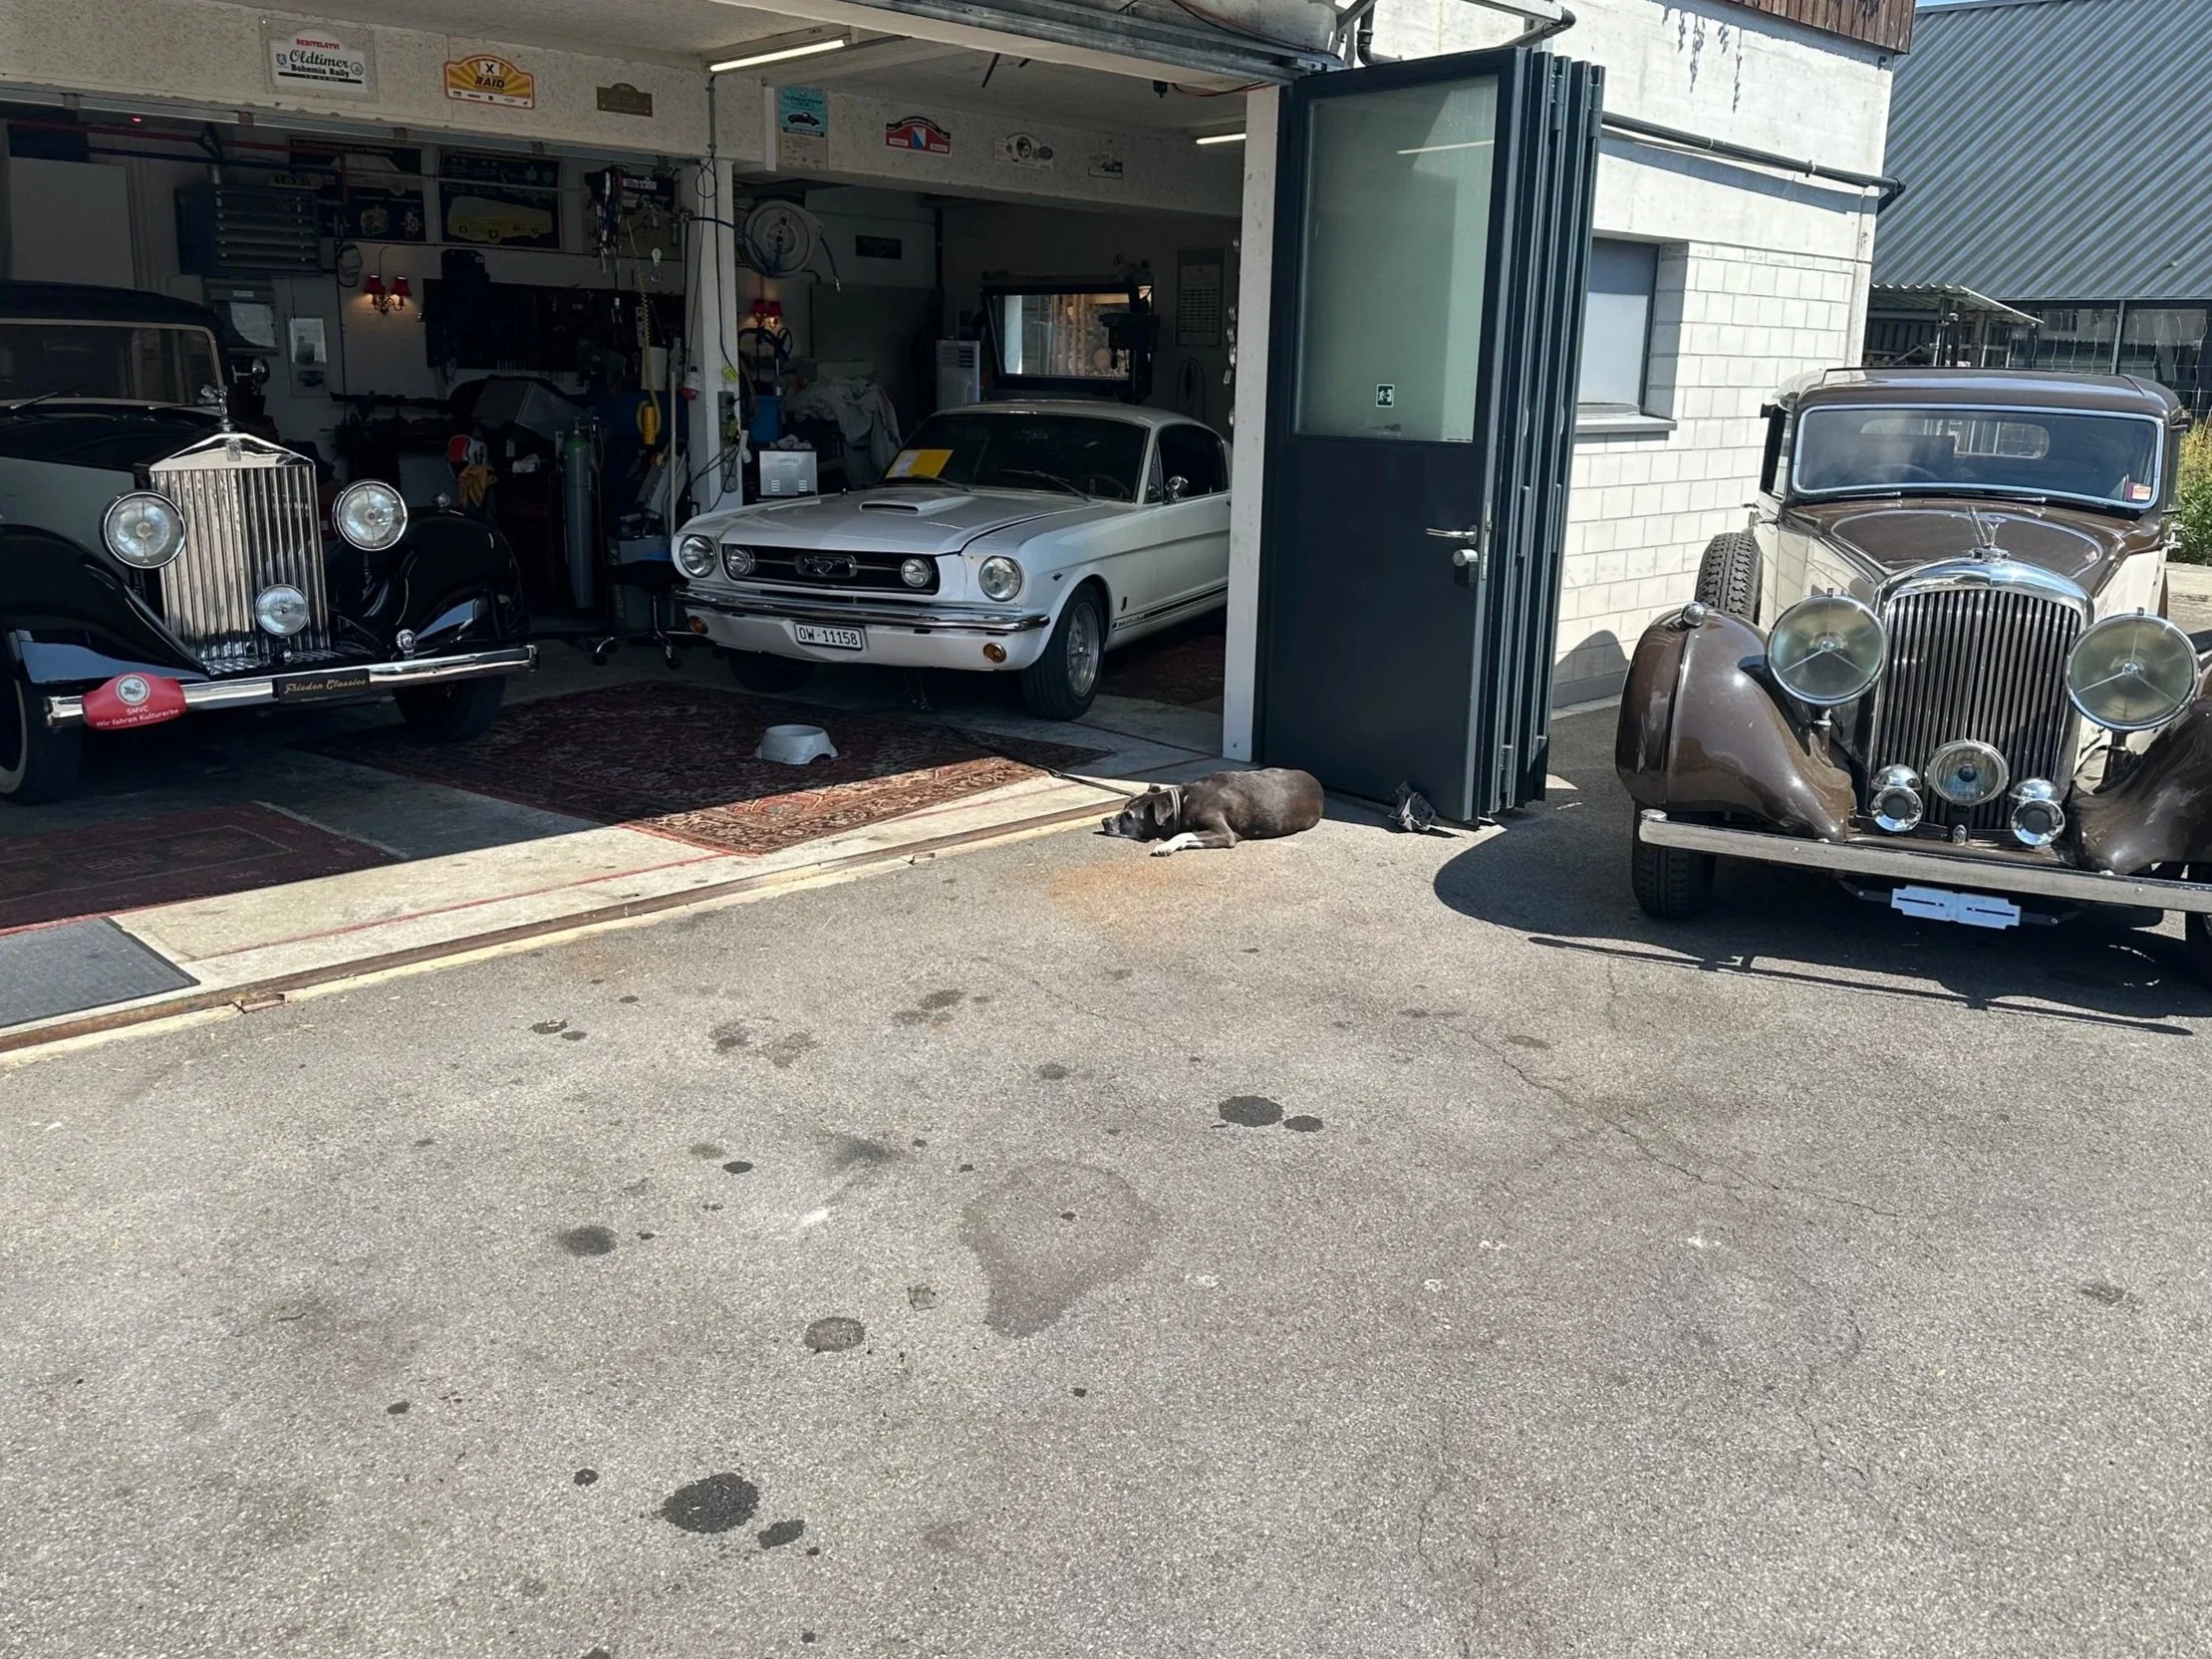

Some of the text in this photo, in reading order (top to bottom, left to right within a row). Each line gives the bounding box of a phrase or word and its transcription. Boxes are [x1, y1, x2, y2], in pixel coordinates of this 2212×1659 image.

[290, 49, 349, 68] Oldtimer
[291, 64, 350, 78] Bohemia Rally
[485, 63, 494, 74] X
[474, 76, 505, 89] RAID
[284, 678, 368, 693] Frieden Classics
[112, 715, 138, 725] fahren
[138, 708, 179, 720] Kulturerbe
[127, 704, 149, 715] SMVC
